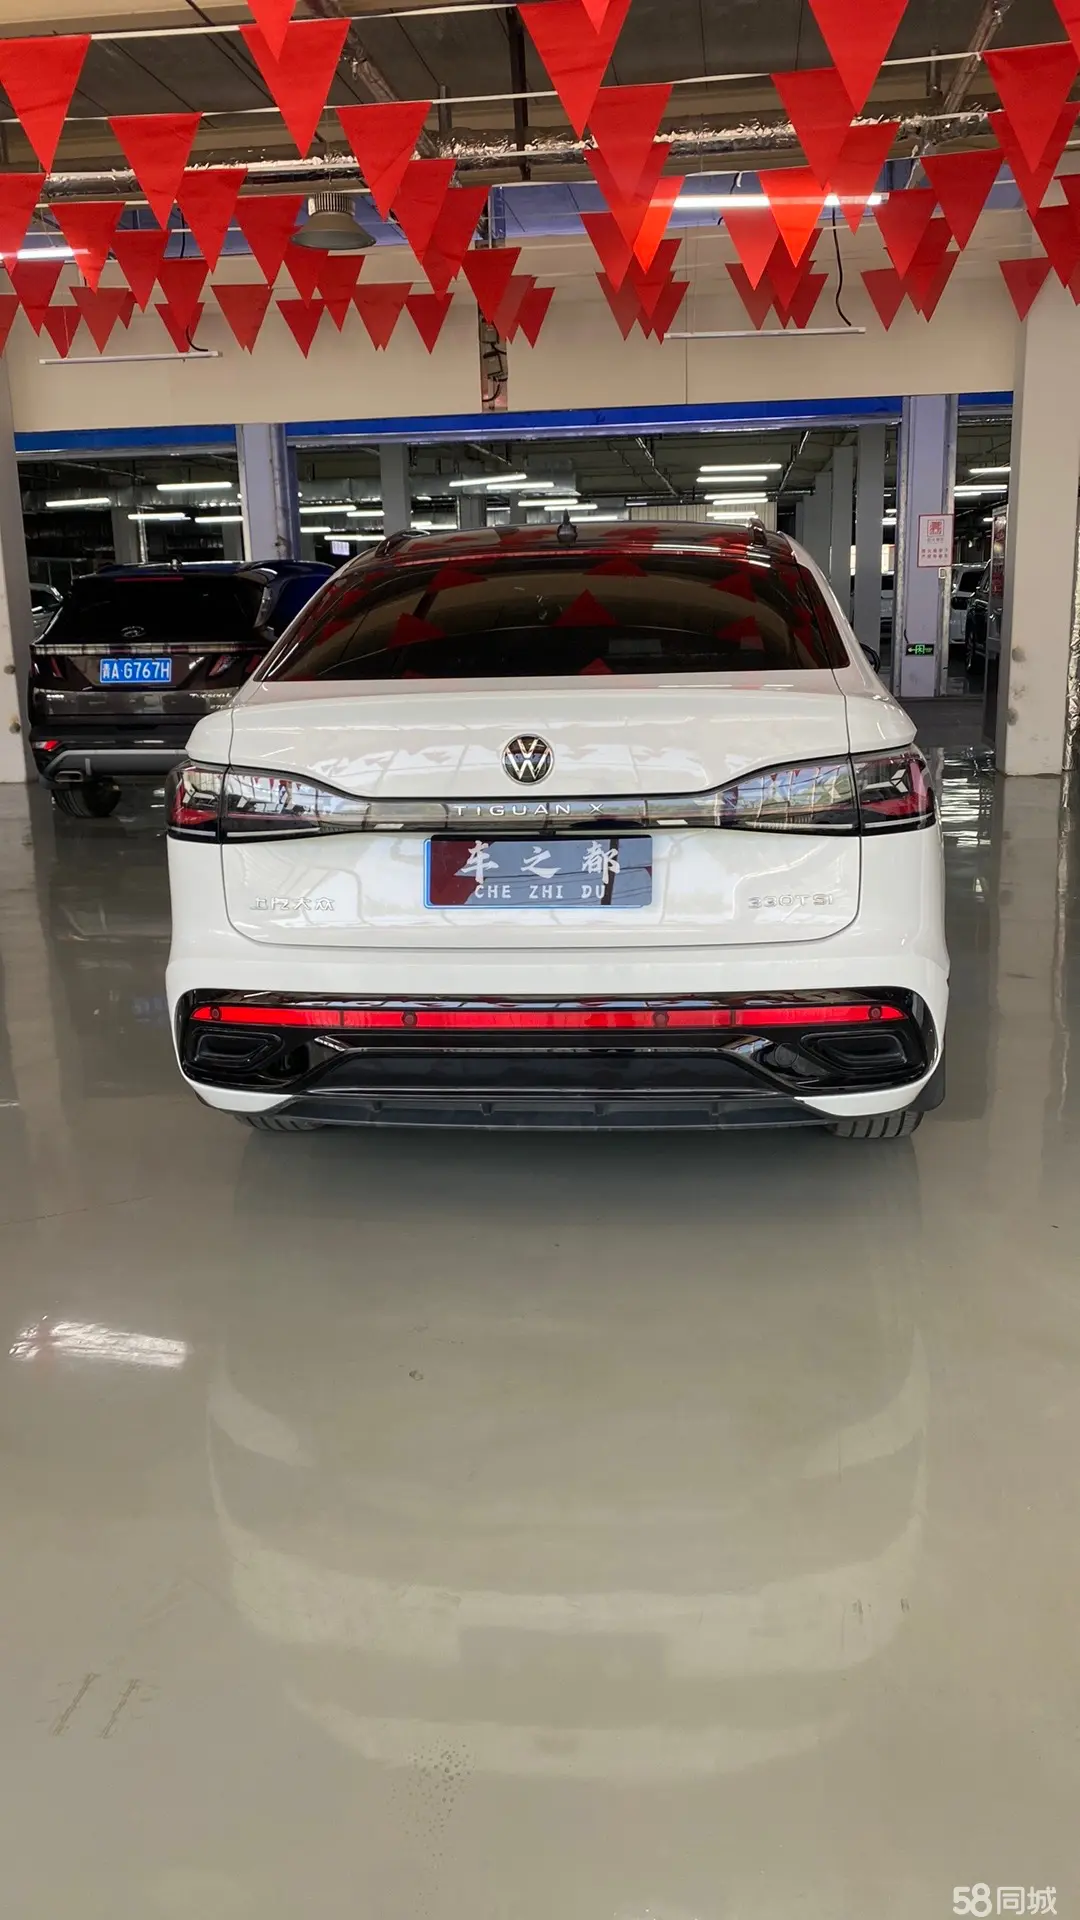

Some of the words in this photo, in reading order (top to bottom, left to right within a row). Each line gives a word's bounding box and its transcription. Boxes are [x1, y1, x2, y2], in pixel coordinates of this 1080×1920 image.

[453, 804, 571, 816] TIGUAN
[590, 803, 604, 814] X
[460, 840, 621, 885] 车之都
[474, 884, 512, 899] CHE
[528, 884, 564, 899] ZHI
[581, 884, 606, 899] DU
[249, 896, 335, 911] 上汽大众
[748, 893, 834, 909] 330TSI
